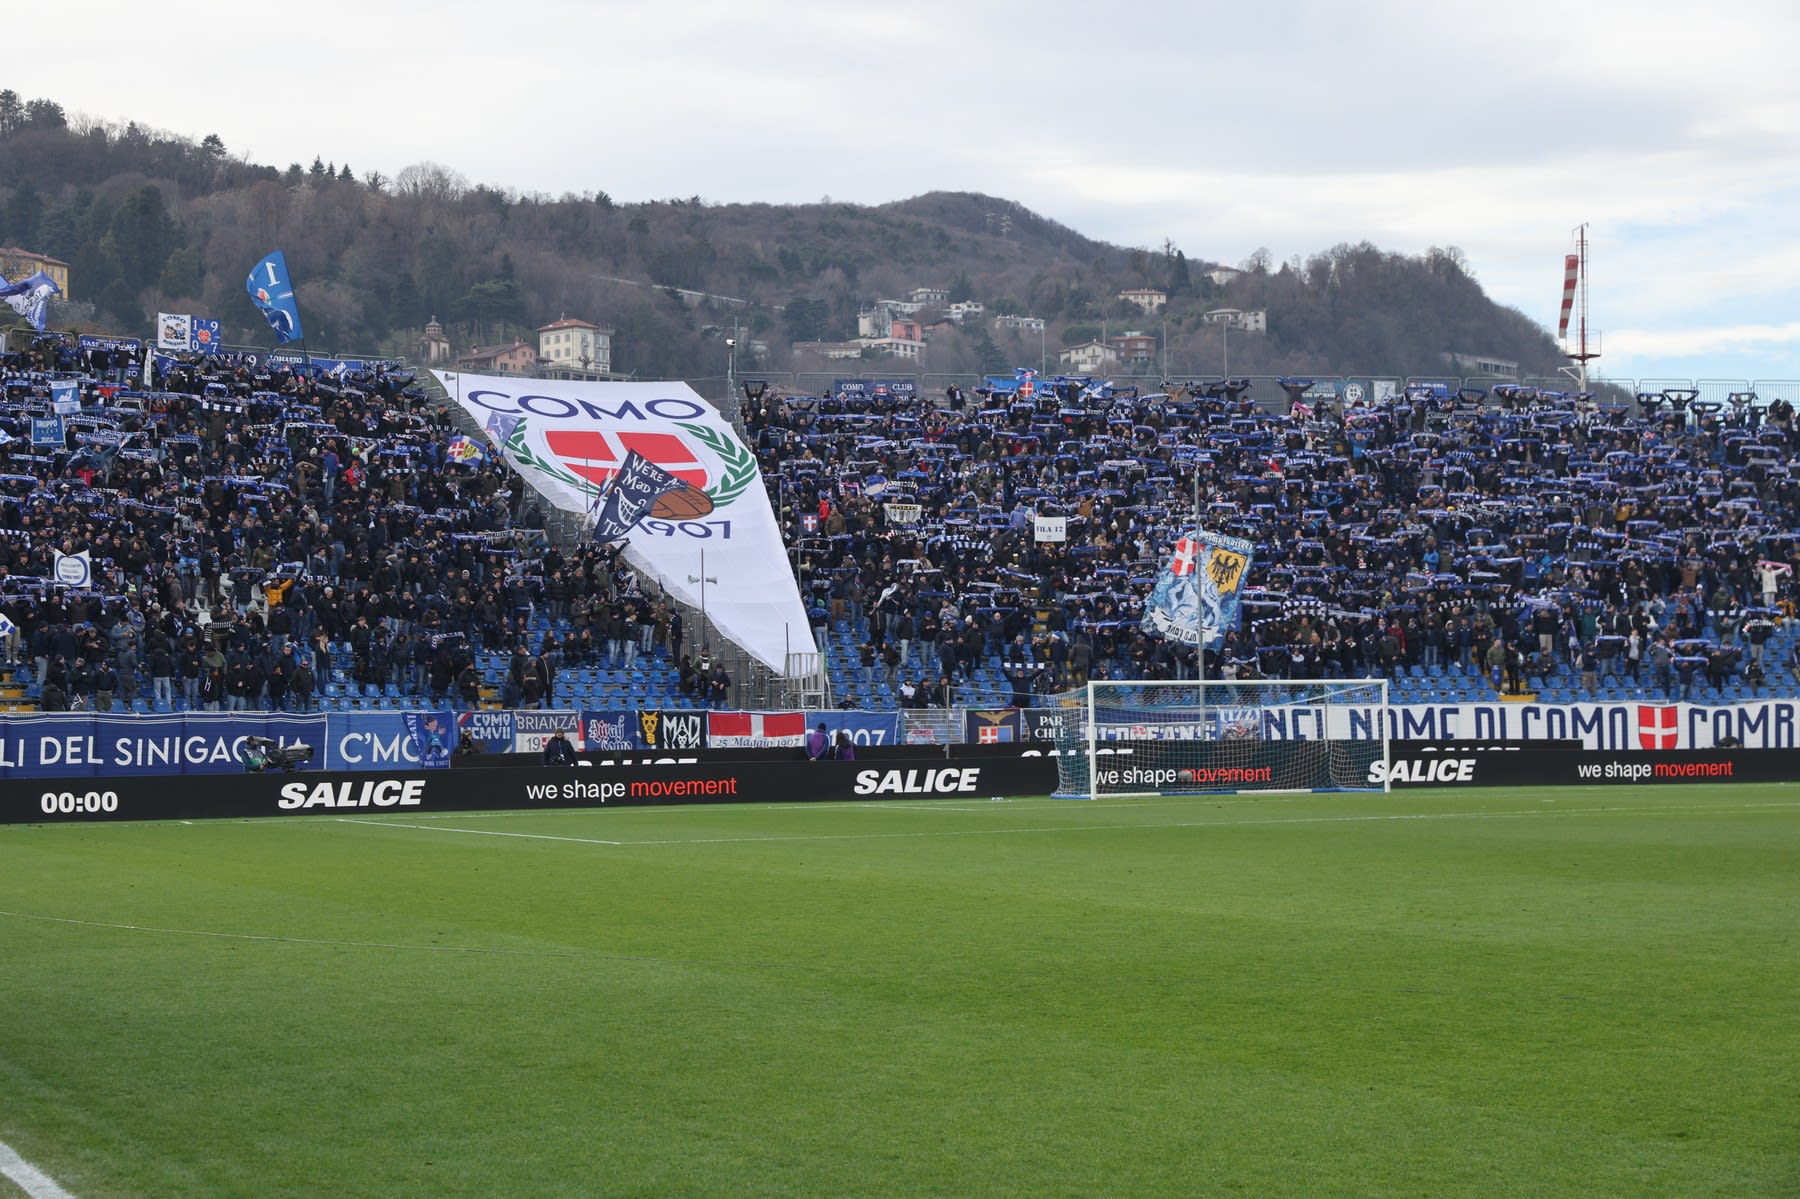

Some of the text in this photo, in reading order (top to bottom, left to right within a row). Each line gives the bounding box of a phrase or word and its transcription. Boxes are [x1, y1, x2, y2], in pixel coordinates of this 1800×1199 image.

[163, 316, 186, 324] COMO
[467, 390, 706, 421] COMO
[516, 715, 578, 731] BRIANZA
[1039, 715, 1063, 727] PAR
[40, 735, 104, 765] DEL
[853, 767, 981, 795] SALICE
[1122, 766, 1177, 788] shape
[1180, 765, 1272, 783] movement
[1367, 758, 1477, 784] SALICE
[1577, 760, 1734, 782] we shape movement
[277, 780, 426, 810] SALICE
[526, 776, 737, 803] we shape movement
[41, 791, 119, 814] 00:00
